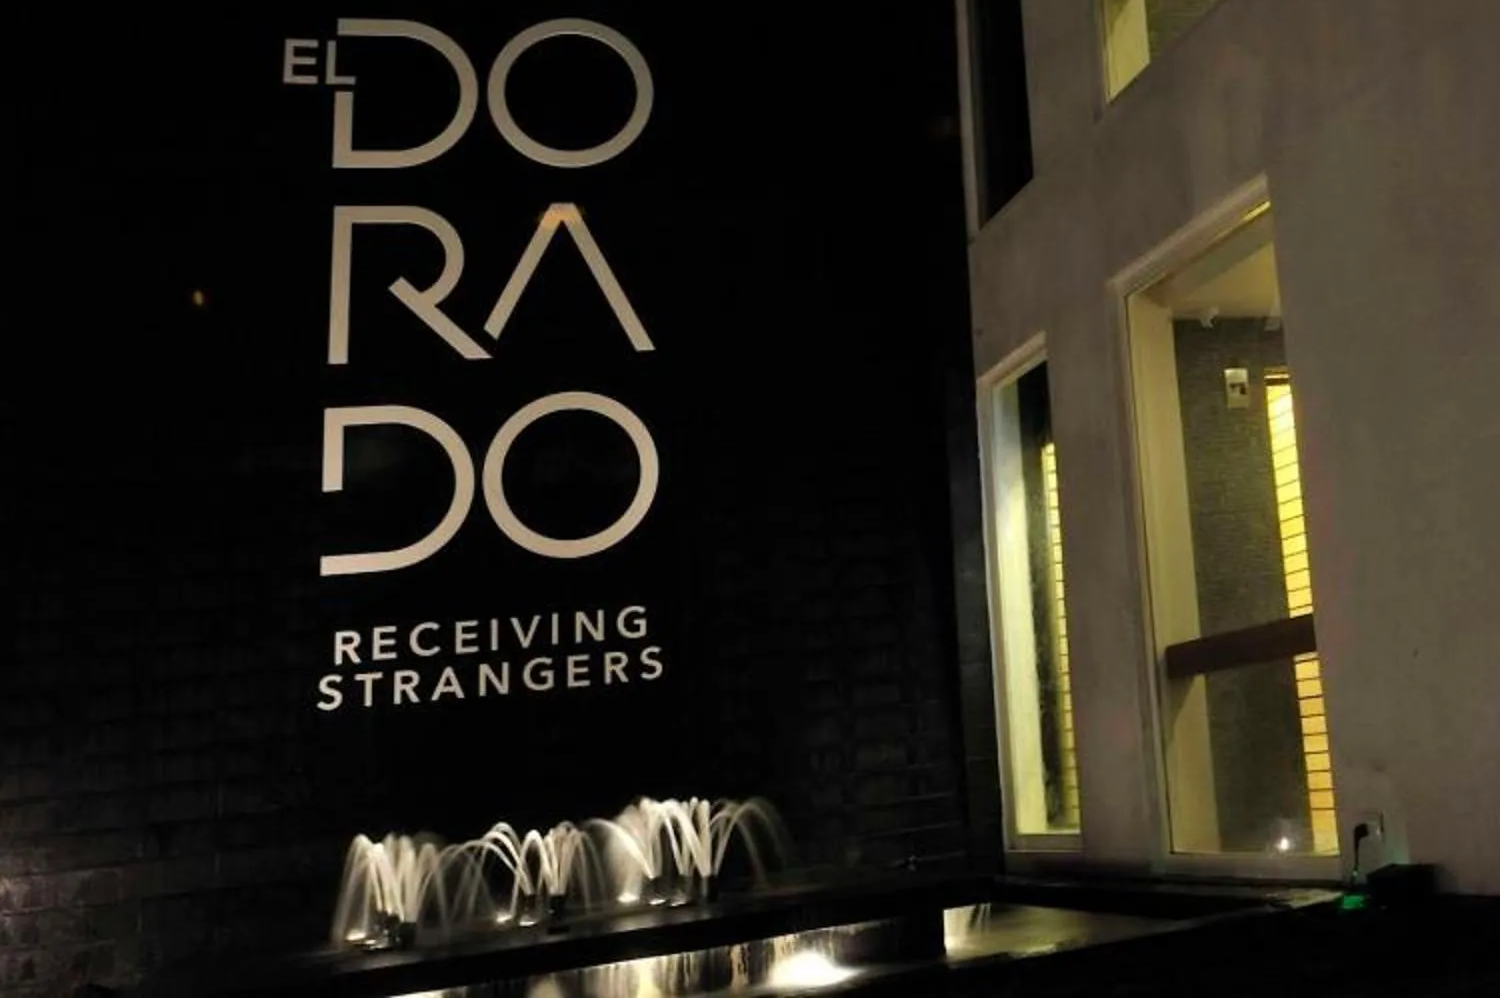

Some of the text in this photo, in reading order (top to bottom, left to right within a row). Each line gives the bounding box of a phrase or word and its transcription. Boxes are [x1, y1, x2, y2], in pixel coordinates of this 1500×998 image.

[282, 38, 356, 85] EL
[334, 605, 648, 666] RECEIVING
[316, 646, 664, 711] STRANGERS
